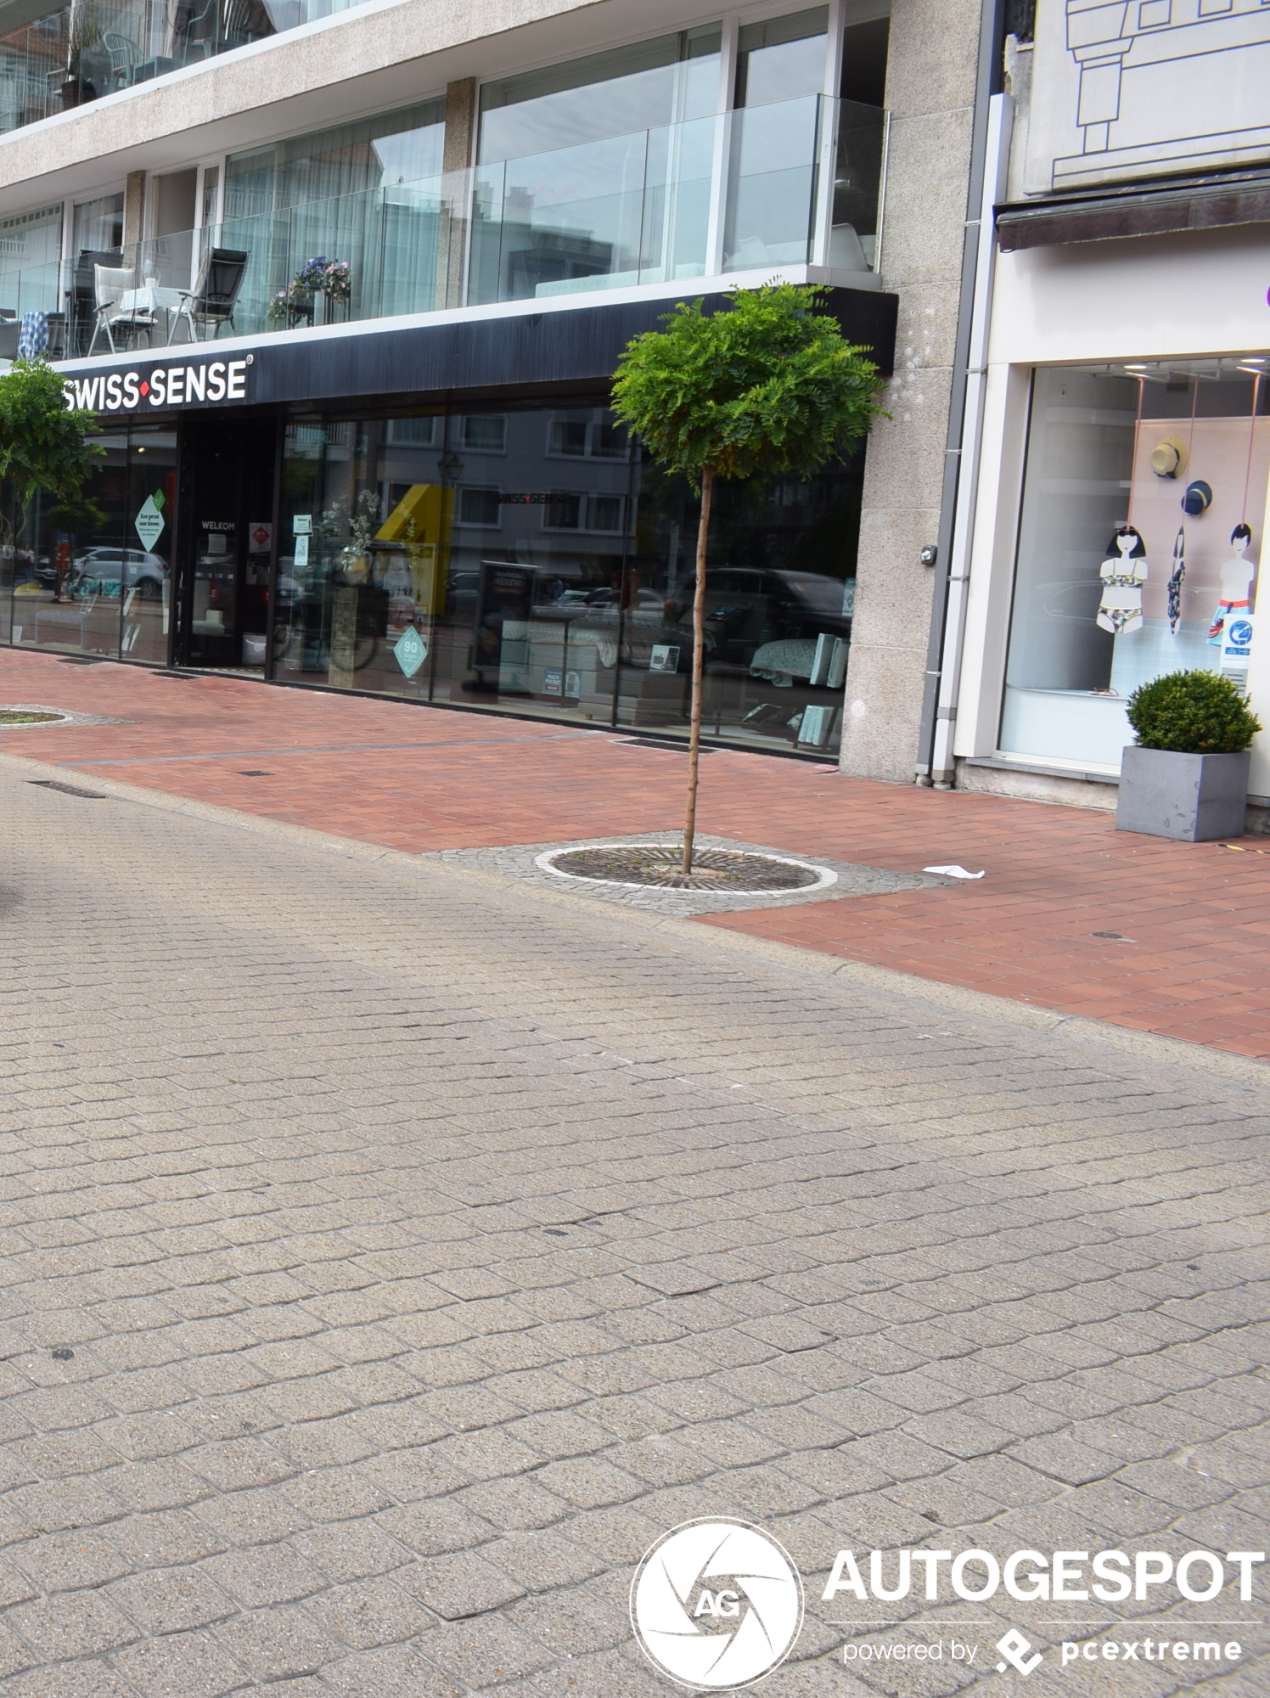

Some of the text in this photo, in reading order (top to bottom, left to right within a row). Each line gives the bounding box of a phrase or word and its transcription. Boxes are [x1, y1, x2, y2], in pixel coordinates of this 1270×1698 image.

[62, 371, 140, 411] SWISS
[202, 520, 235, 531] WELKOM
[403, 641, 418, 653] 90
